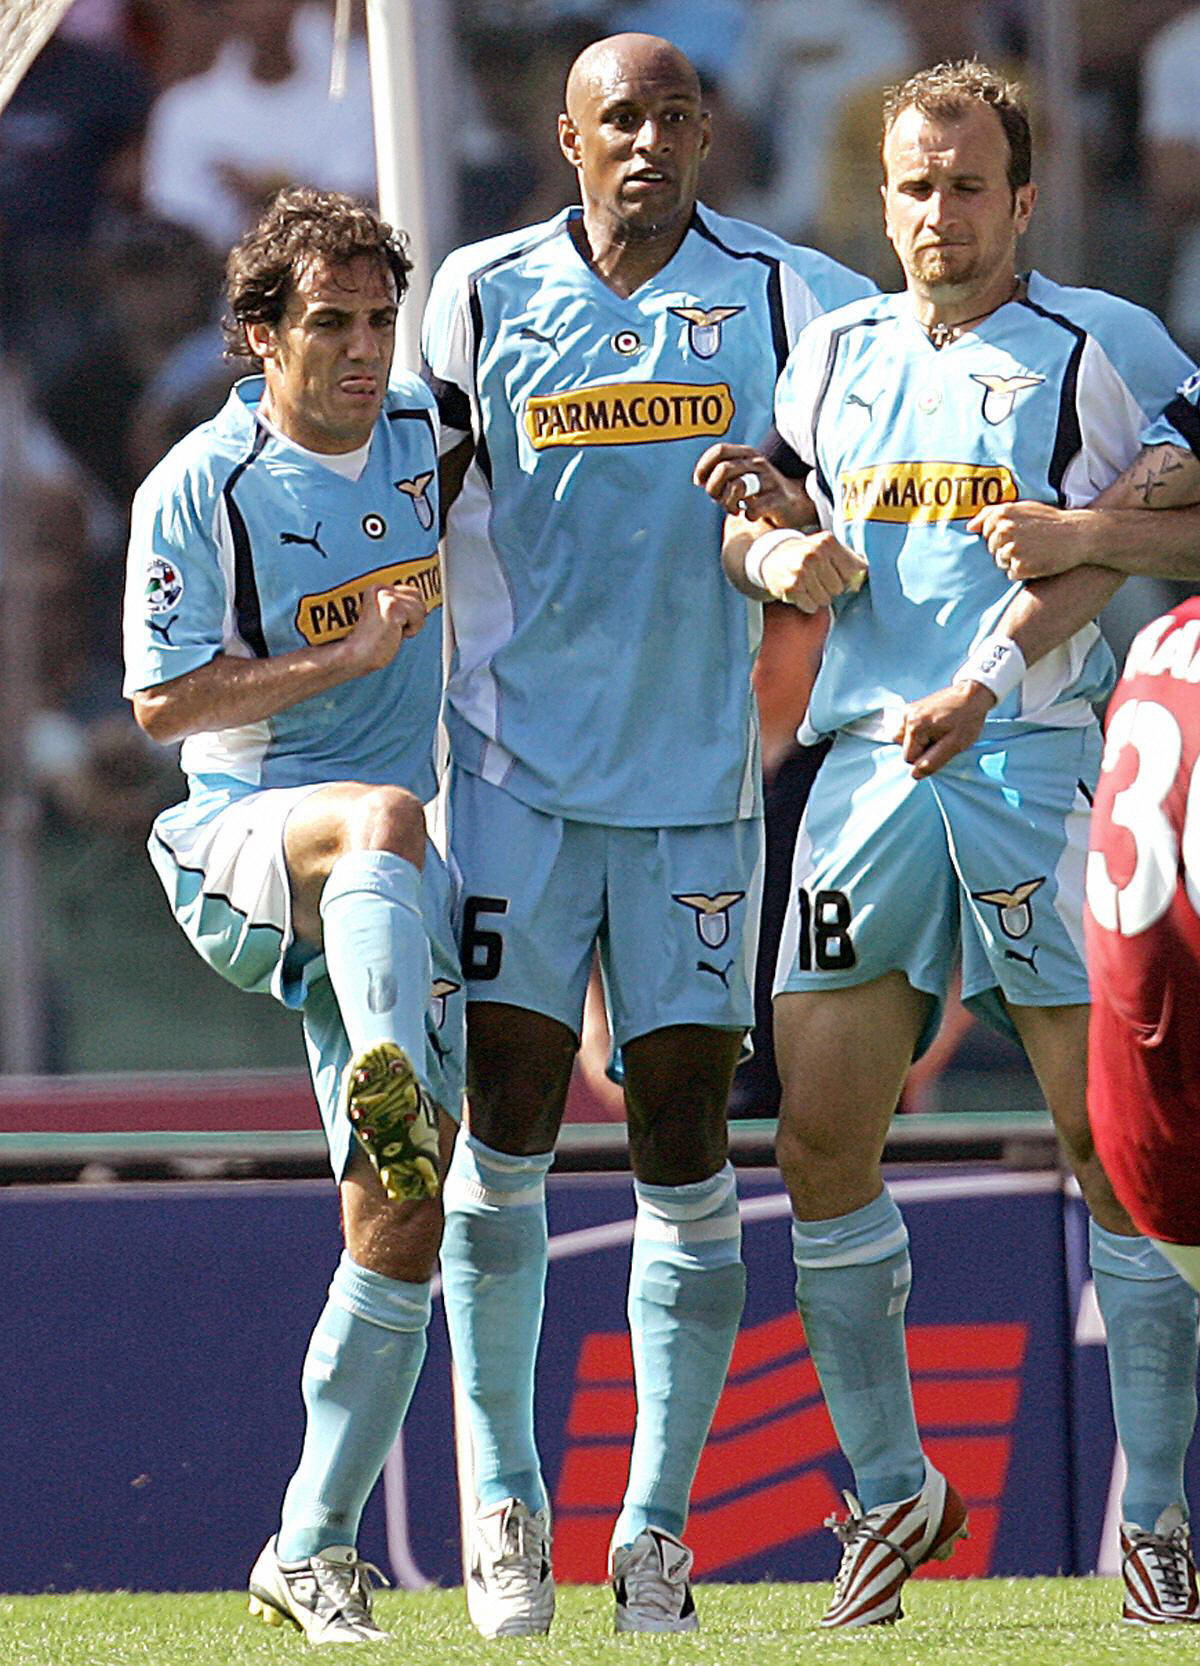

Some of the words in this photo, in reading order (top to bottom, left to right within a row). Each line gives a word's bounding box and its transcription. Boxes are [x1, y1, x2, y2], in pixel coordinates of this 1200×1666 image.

[533, 394, 723, 437] PARMACOTTO
[841, 476, 1003, 510] PAMACOTTO
[461, 896, 509, 981] 6
[799, 887, 857, 970] 18
